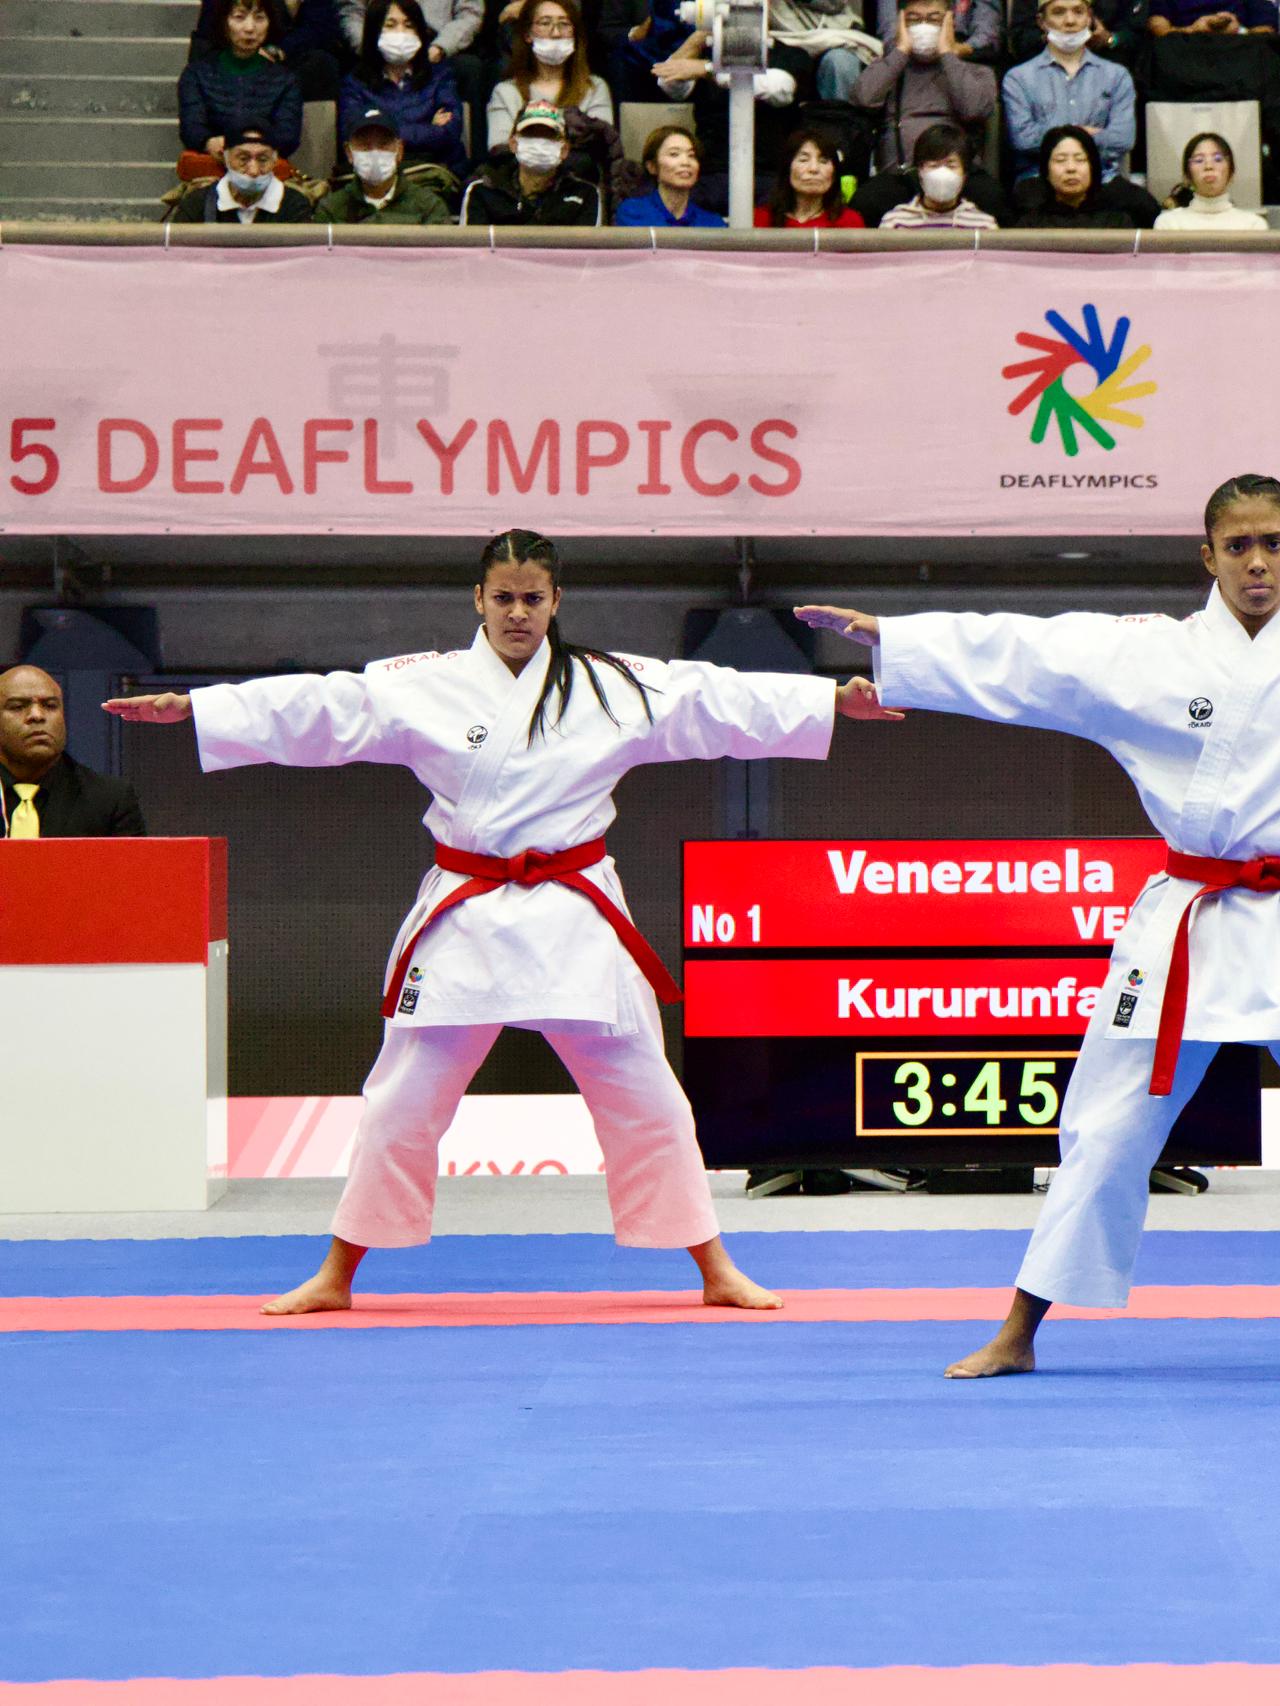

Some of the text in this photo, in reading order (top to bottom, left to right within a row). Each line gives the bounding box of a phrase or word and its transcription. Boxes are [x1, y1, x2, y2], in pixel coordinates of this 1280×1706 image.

[10, 417, 802, 496] 5 DEAFLYMPICS
[1000, 474, 1158, 489] DEAFLYMPICS
[828, 848, 1114, 894] Venezuela
[691, 905, 761, 943] No 1
[1072, 906, 1133, 939] VE
[838, 977, 1102, 1018] Kururunfa
[892, 1061, 1059, 1126] 3:45
